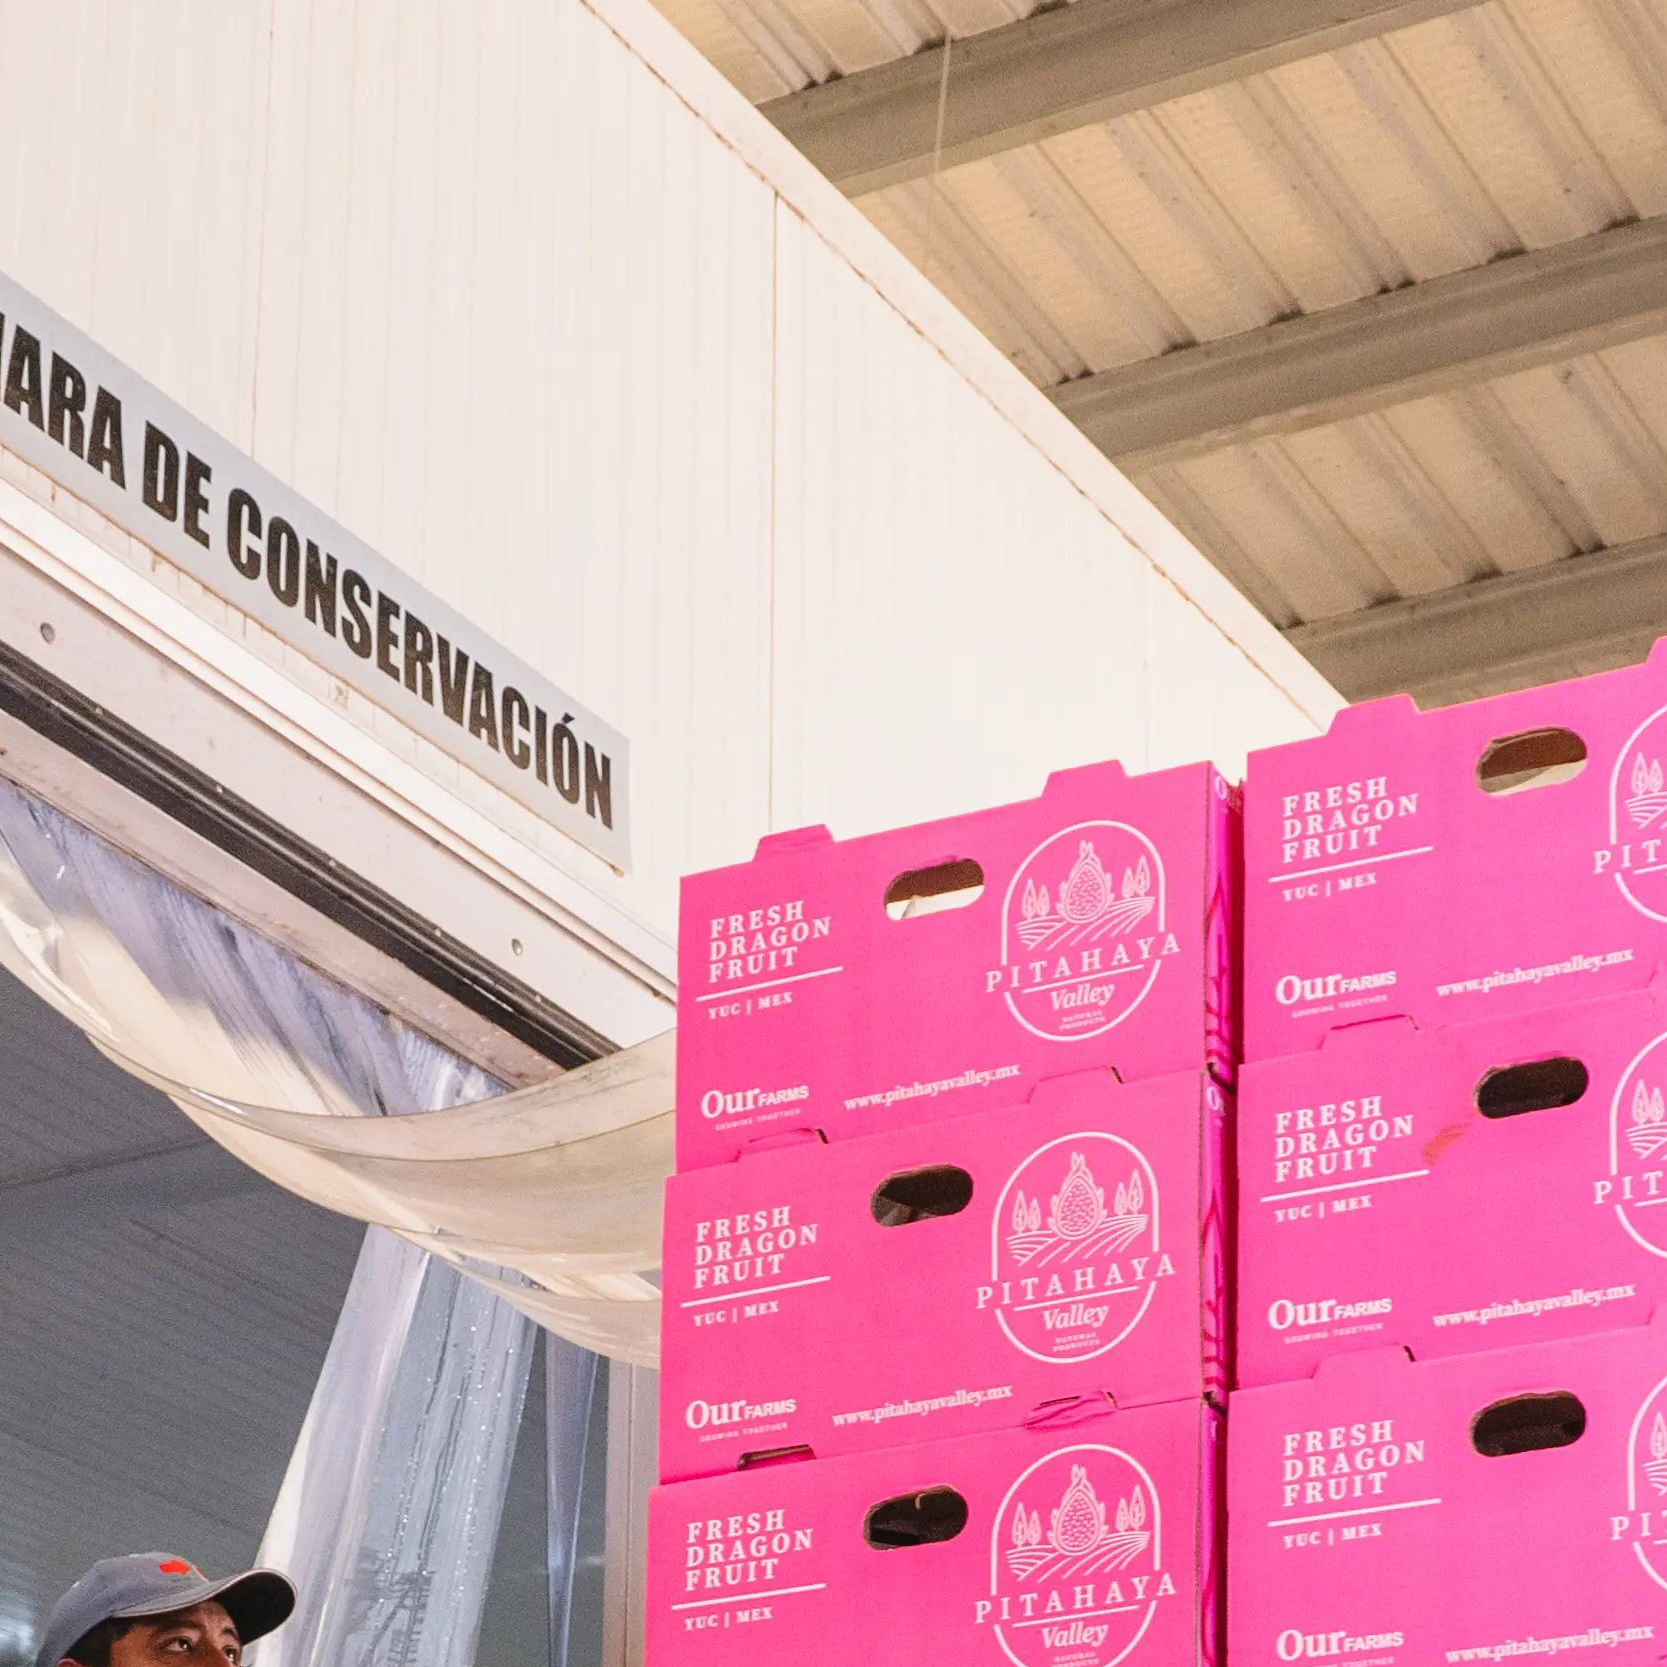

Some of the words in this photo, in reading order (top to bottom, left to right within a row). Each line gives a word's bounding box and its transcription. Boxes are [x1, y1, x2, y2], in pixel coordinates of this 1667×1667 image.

[144, 421, 211, 548] DE
[228, 489, 610, 823] CONSERVACIÓN
[1283, 777, 1386, 817] FRESH
[1283, 793, 1418, 840] DRAGON
[1283, 825, 1381, 863] FRUIT
[1283, 884, 1318, 901] YUC
[1339, 873, 1376, 890] MEX
[711, 901, 803, 938] FRESH
[710, 917, 830, 961] DRAGON
[709, 946, 797, 983] FRUIT
[986, 933, 1180, 992] PITAHAYA
[1436, 949, 1633, 996] www.pitahayavalley.mx
[709, 1003, 740, 1019] YUC
[758, 992, 792, 1009] MEX
[1050, 983, 1115, 1010] Valley
[844, 1065, 1020, 1110] www.pitahayavalley.mx
[1276, 1096, 1381, 1134] FRESH
[1275, 1115, 1413, 1158] DRAGON
[1275, 1146, 1376, 1182] FRUIT
[696, 1206, 790, 1242] FRESH
[1275, 1205, 1311, 1222] YUC
[1333, 1195, 1371, 1212] MEX
[696, 1224, 817, 1265] DRAGON
[694, 1253, 784, 1289] FRUIT
[976, 1254, 1175, 1309] PITAHAYA
[694, 1311, 725, 1326] YUC
[745, 1301, 778, 1317] MEX
[1043, 1303, 1109, 1330] Valley
[1433, 1284, 1635, 1326] www.pitahayavalley.mx
[832, 1386, 1012, 1426] www.pitahayavalley.mx
[1284, 1420, 1392, 1456] FRESH
[1284, 1440, 1424, 1481] DRAGON
[1283, 1472, 1387, 1507] FRUIT
[687, 1509, 784, 1543] FRESH
[1283, 1532, 1320, 1548] YUC
[1342, 1523, 1381, 1540] MEX
[686, 1529, 813, 1567] DRAGON
[685, 1558, 778, 1591] FRUIT
[975, 1573, 1176, 1624] PITAHAYA
[685, 1615, 718, 1630] YUC
[736, 1607, 772, 1623] MEX
[1042, 1621, 1108, 1648] Valley
[1445, 1626, 1654, 1662] www.pitahayavalley.mx
